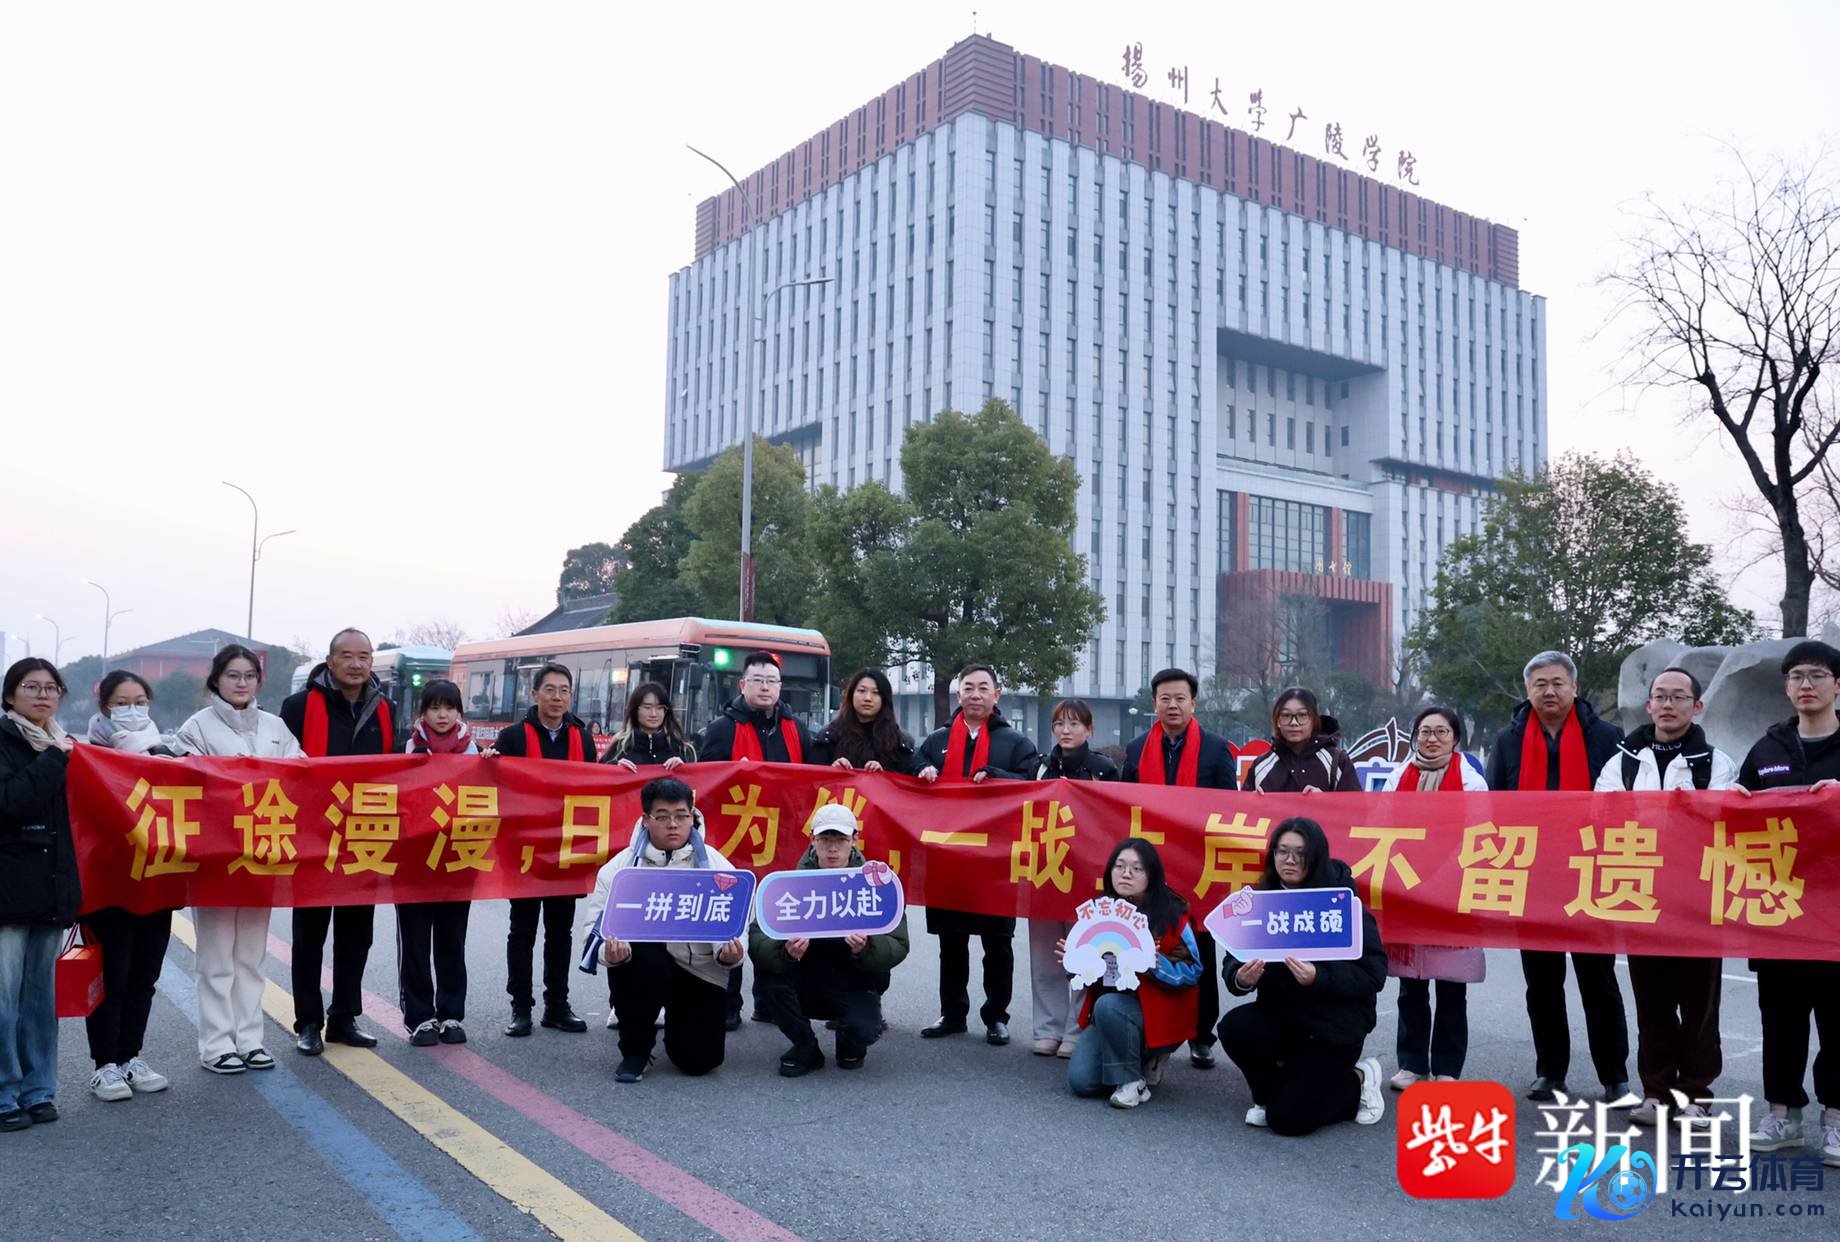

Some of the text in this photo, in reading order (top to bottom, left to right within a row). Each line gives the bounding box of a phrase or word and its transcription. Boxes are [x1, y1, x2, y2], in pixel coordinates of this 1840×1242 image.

[615, 892, 734, 923] 一拼到底
[775, 887, 884, 922] 全力以赴
[1079, 900, 1146, 931] 不忘初心
[1240, 909, 1344, 935] 一战成硕
